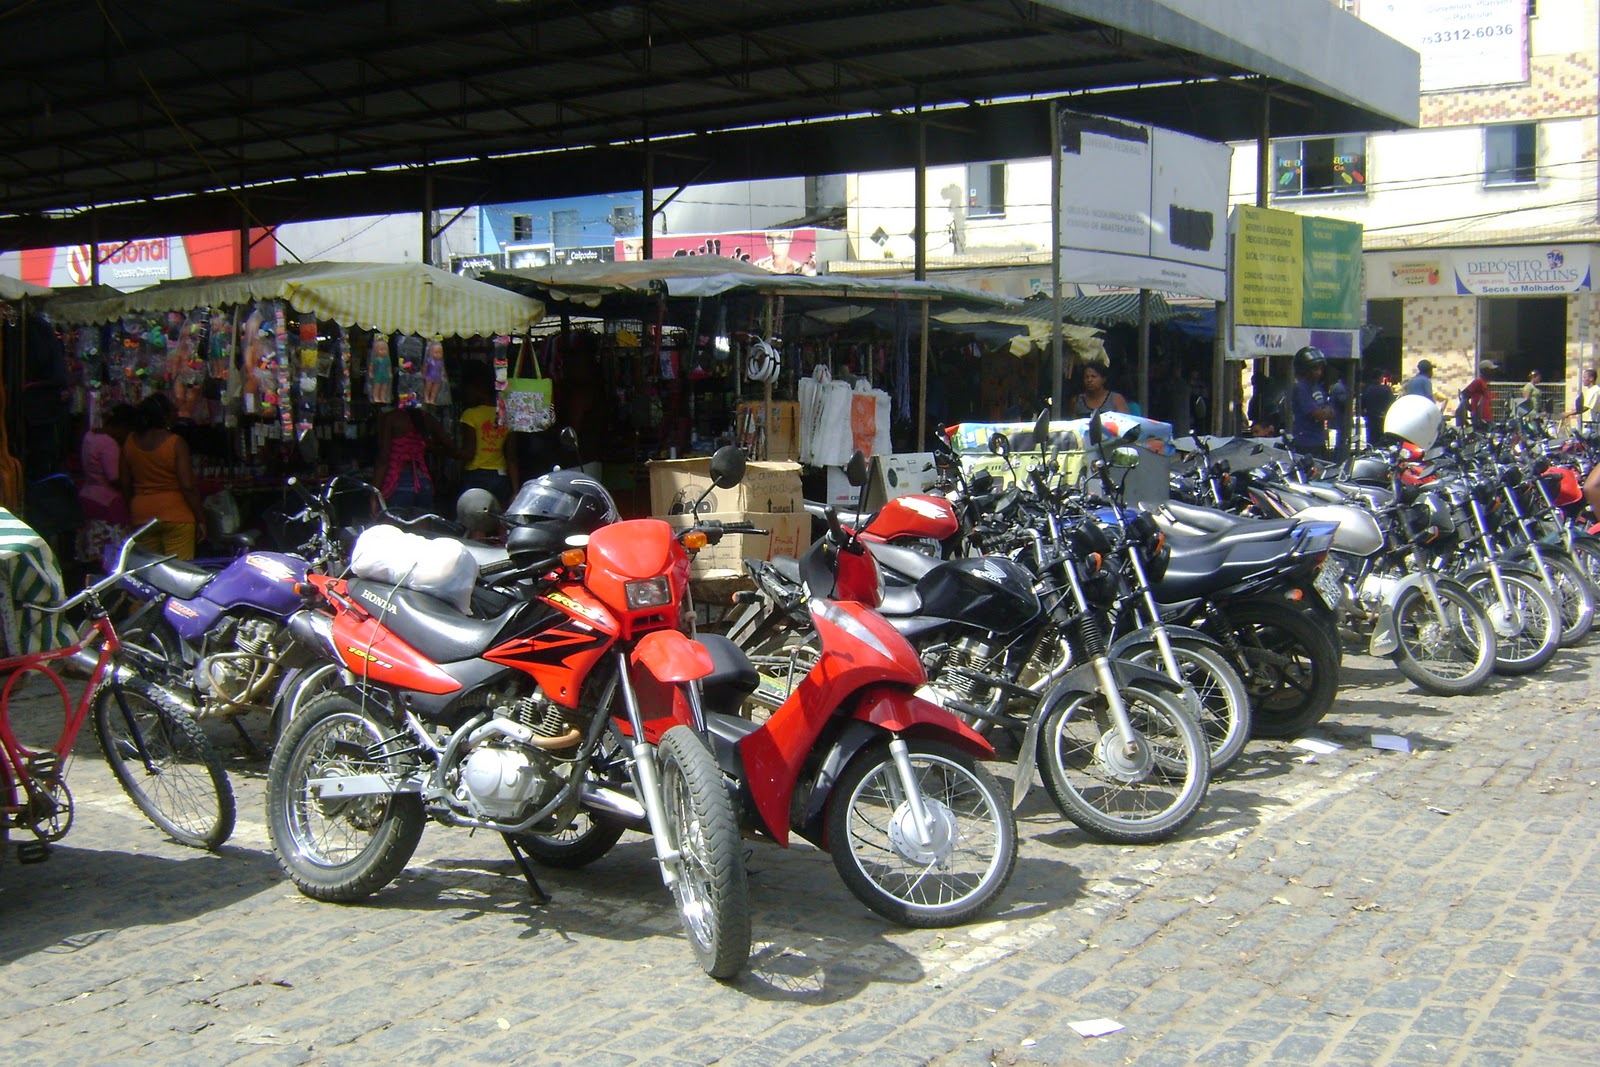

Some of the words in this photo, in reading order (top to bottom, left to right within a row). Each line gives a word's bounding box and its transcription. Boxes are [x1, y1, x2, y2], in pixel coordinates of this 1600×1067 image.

[570, 250, 598, 261] Calçados
[1467, 258, 1543, 273] DEPÓSITO
[1508, 268, 1579, 282] MARTINS
[1521, 284, 1566, 293] Molhados
[361, 589, 398, 615] HONDA
